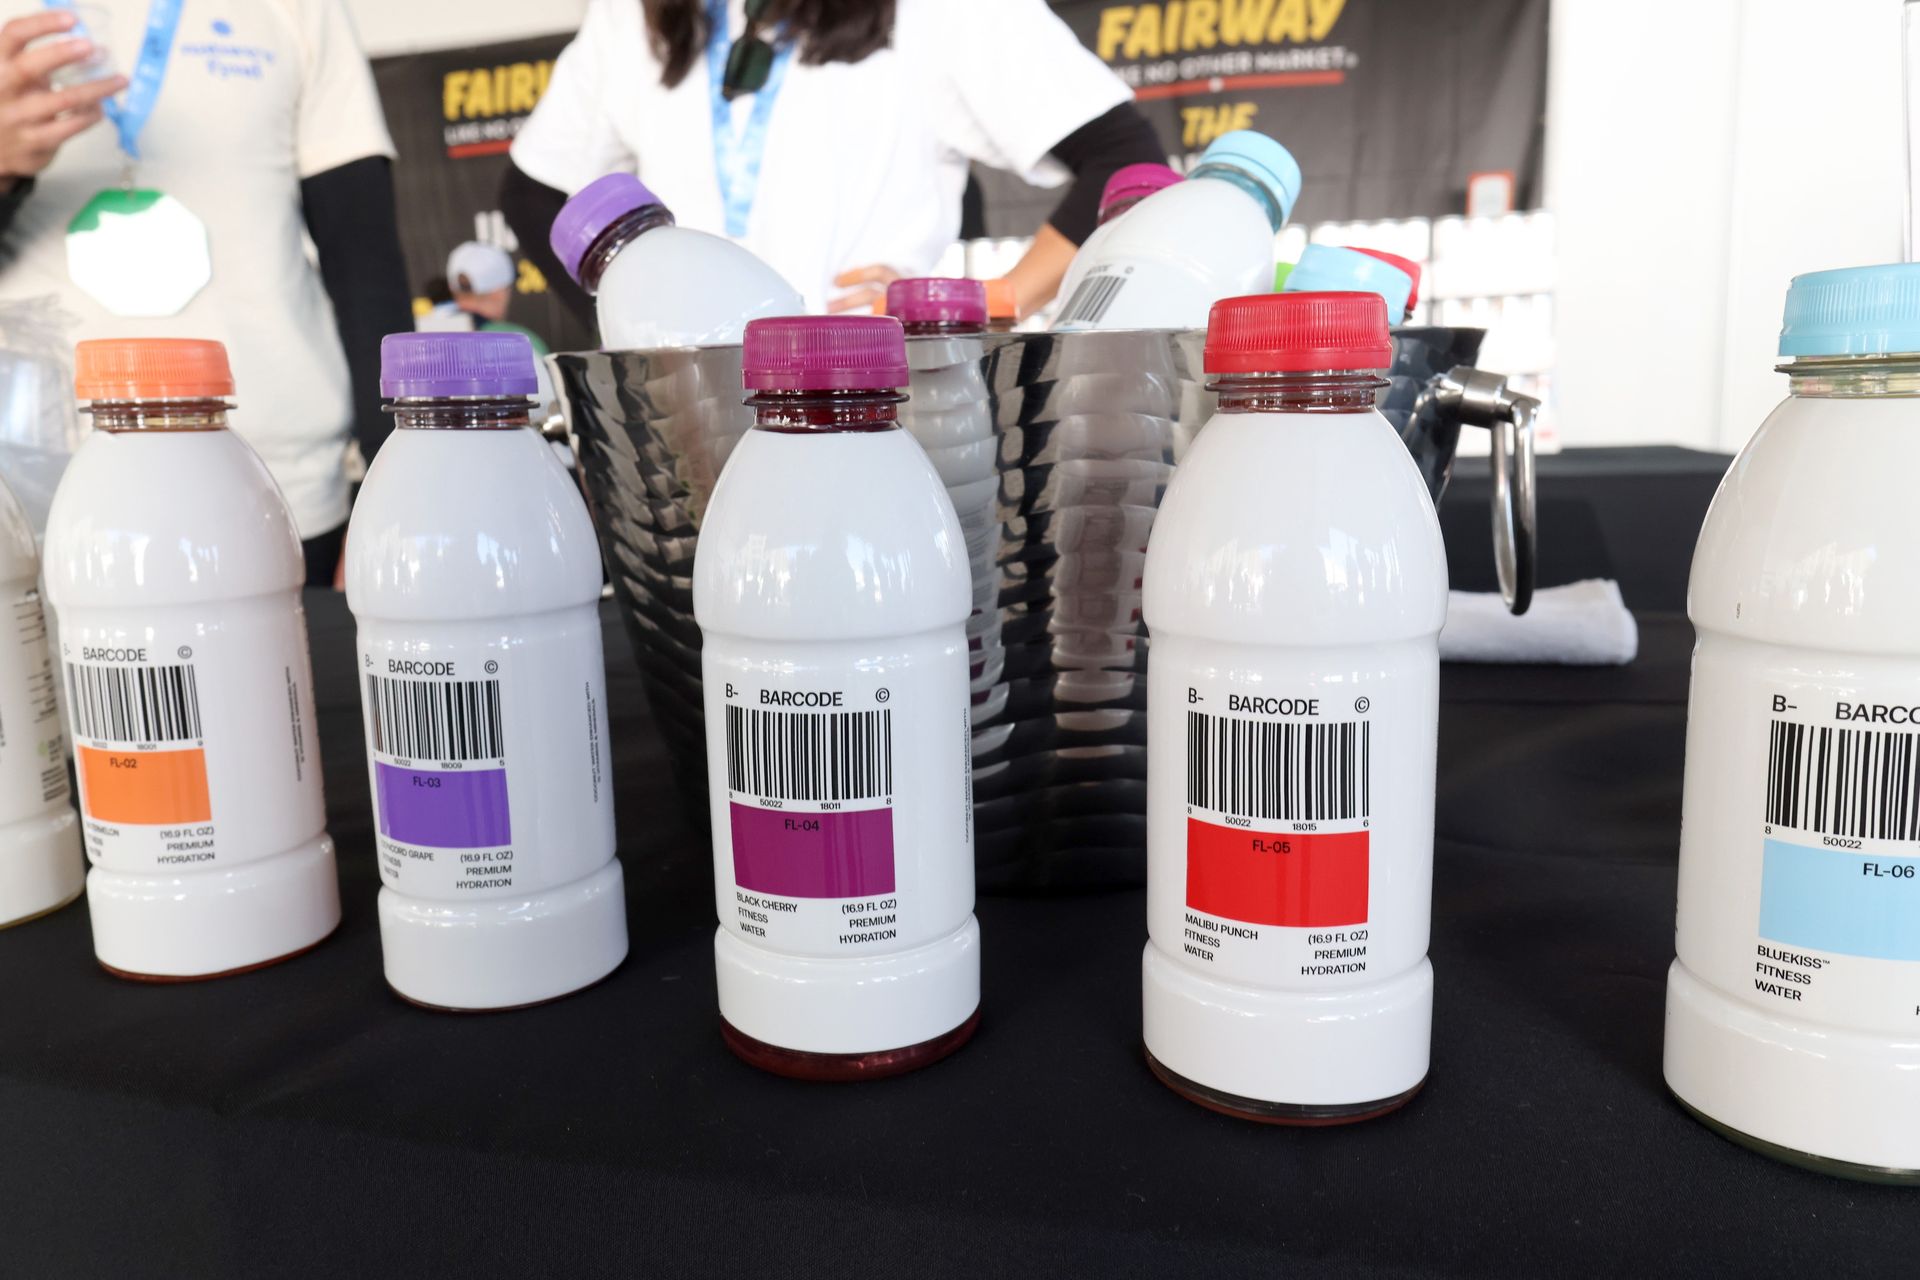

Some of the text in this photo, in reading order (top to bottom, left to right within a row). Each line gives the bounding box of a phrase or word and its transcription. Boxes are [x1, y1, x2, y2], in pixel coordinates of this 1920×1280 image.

[1097, 0, 1349, 61] FAIRWAY
[1178, 51, 1251, 80] OTHER
[83, 646, 147, 661] BARCODE
[388, 659, 455, 675] BARCODE
[760, 689, 843, 707] BARCODE
[1228, 694, 1319, 716] BARCODE
[1772, 694, 1797, 712] B-
[110, 757, 137, 769] FL-02
[413, 775, 441, 787] FL-03
[760, 799, 783, 808] 50022
[886, 797, 892, 805] 8
[784, 819, 820, 831] FL-04
[1187, 806, 1369, 831] 8 50022 18015 6
[160, 826, 214, 839] (16.9 FL OZ)
[1764, 826, 1862, 849] 8 50022
[167, 840, 214, 851] PREMIUM
[1252, 839, 1291, 854] FL-05
[157, 852, 215, 864] HYDRATION
[408, 850, 434, 861] GRAPE
[460, 850, 513, 863] (16.9 FL OZ)
[466, 864, 512, 875] PREMIUM
[1863, 863, 1915, 878] FL-06
[456, 878, 512, 889] HYDRATION
[736, 892, 798, 913] BLACK CHERRY
[842, 899, 897, 915] (16.9 FL OZ)
[738, 907, 768, 923] FITNESS
[849, 914, 896, 928] PREMIUM
[739, 922, 766, 937] WATER
[1185, 913, 1258, 940] MALIBU PUNCH
[839, 929, 896, 944] HYDRATION
[1184, 928, 1220, 948] FITNESS
[1308, 930, 1368, 945] (16.9 FL OZ)
[1184, 943, 1214, 961] WATER
[1314, 946, 1367, 959] PREMIUM
[1301, 962, 1366, 975] HYDRATION
[1756, 962, 1811, 985] FITNESS
[1755, 978, 1802, 1001] WATER
